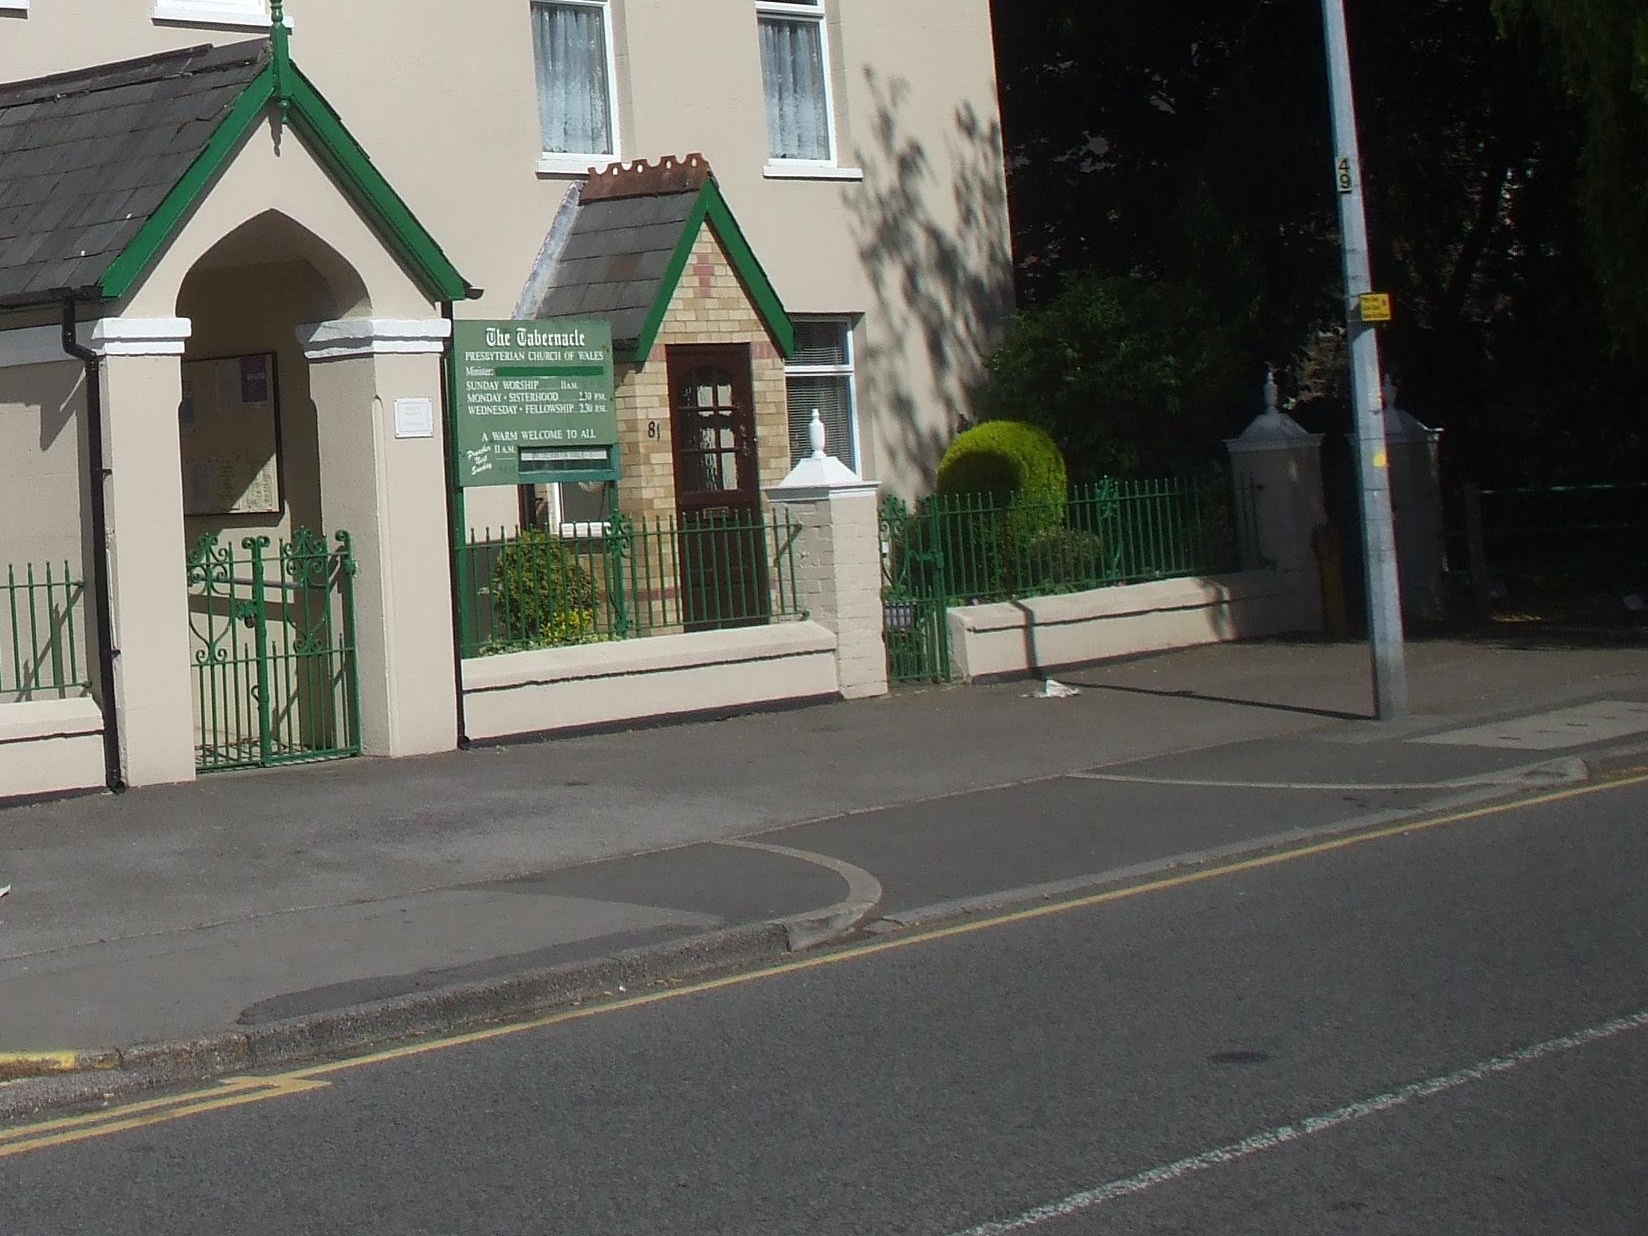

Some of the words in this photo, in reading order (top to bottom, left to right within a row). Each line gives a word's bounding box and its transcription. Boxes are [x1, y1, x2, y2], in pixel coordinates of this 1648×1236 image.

[486, 327, 511, 346] The
[516, 327, 585, 346] Tabernacle
[465, 351, 525, 361] PRESBYTERIAN
[528, 351, 561, 361] CHURCH
[564, 351, 575, 361] OF
[577, 351, 604, 361] WALES
[466, 380, 499, 391] SUNDAY
[502, 380, 539, 390] WORSHIP
[467, 393, 502, 403] MONDAY
[508, 392, 559, 403] SISTERHOOD
[579, 392, 593, 401] 2.30
[468, 405, 518, 415] WEDNESDAY
[525, 404, 574, 414] FELLOWSHIP
[579, 403, 593, 413] 2.30
[481, 432, 488, 442] A
[492, 431, 518, 441] WARM
[521, 430, 562, 440] WELCOME
[566, 429, 577, 439] TO
[581, 429, 596, 439] ALL
